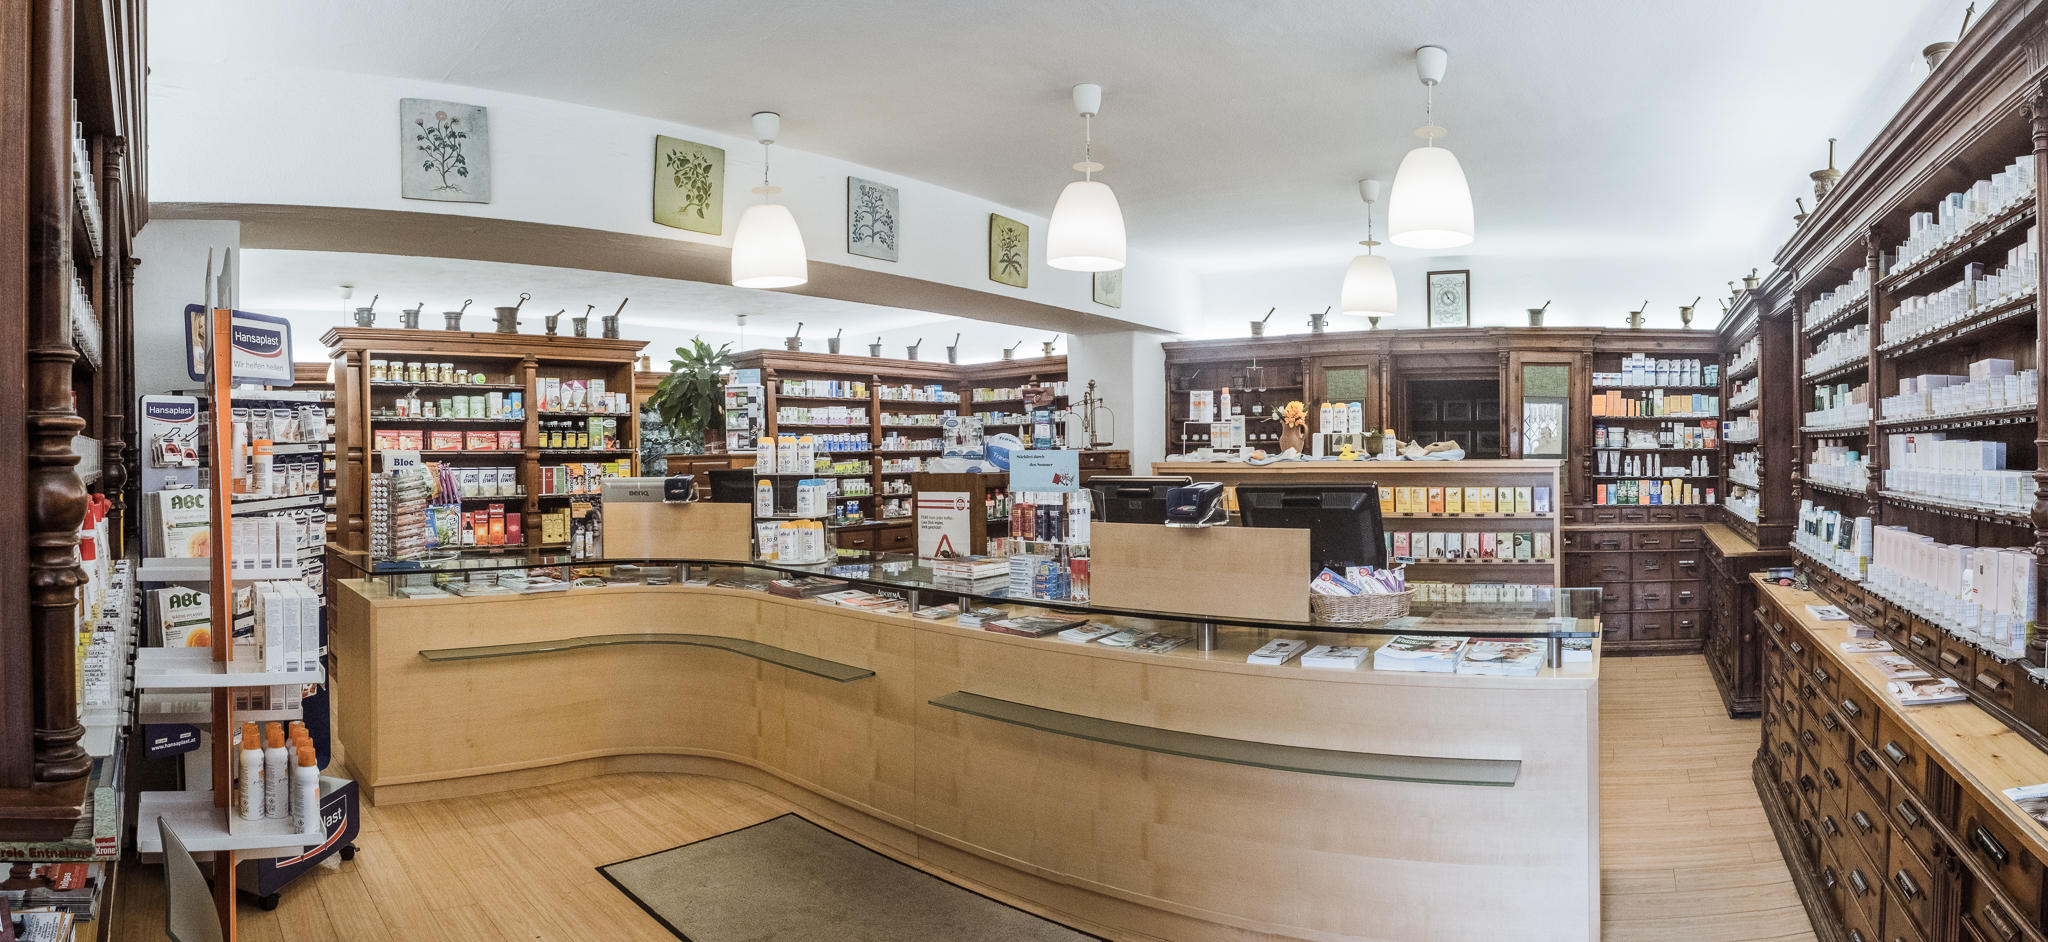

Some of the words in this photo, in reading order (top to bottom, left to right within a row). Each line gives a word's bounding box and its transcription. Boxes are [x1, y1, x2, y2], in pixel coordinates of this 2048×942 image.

[234, 331, 279, 346] Hansaplast
[149, 406, 192, 415] Hansaplast
[393, 458, 414, 466] Bloc
[171, 494, 205, 510] ABC
[169, 592, 202, 609] ABC
[151, 737, 196, 751] www.hansaplast.at
[0, 847, 25, 858] reie
[28, 847, 93, 858] Entnahme
[95, 847, 116, 855] Krone
